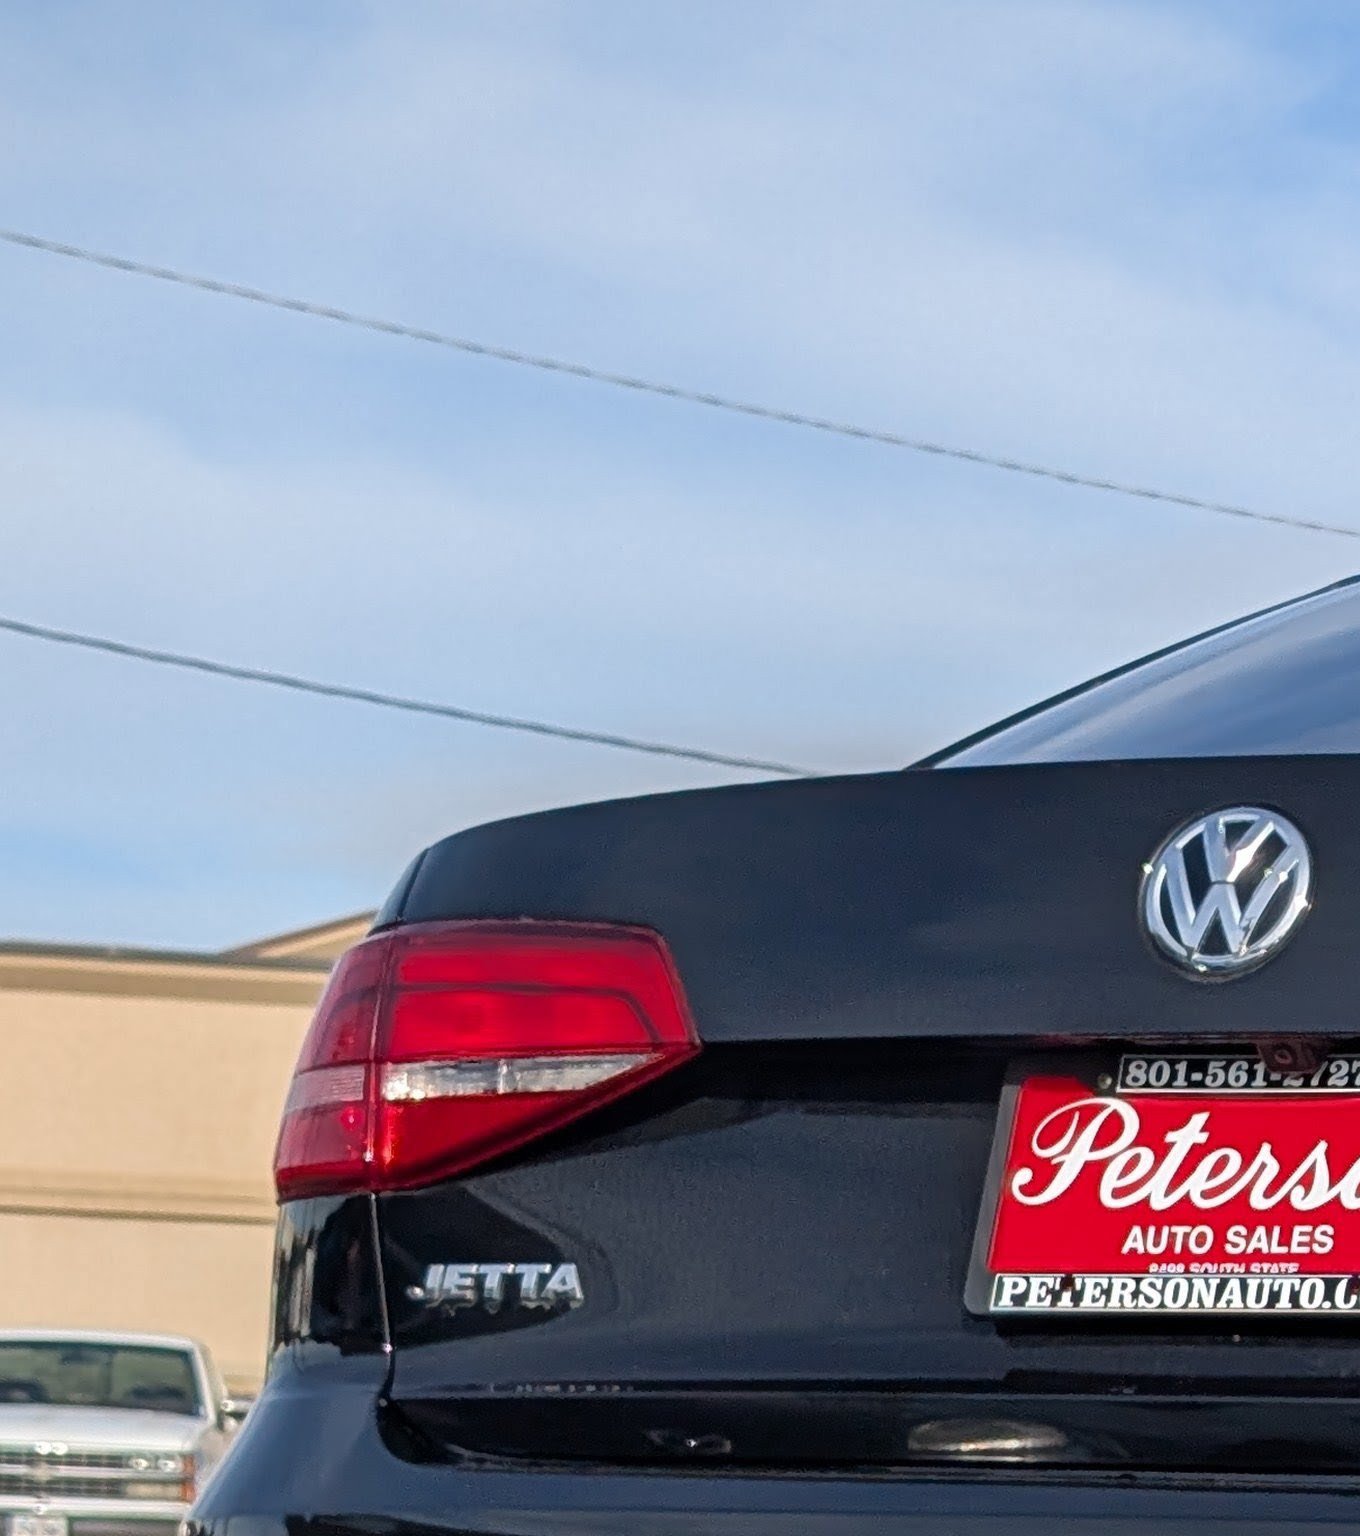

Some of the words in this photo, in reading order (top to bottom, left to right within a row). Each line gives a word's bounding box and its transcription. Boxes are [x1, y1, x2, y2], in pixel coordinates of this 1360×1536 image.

[1121, 1224, 1215, 1254] AUTO
[1224, 1224, 1335, 1254] SALES
[405, 1263, 584, 1303] JETTA
